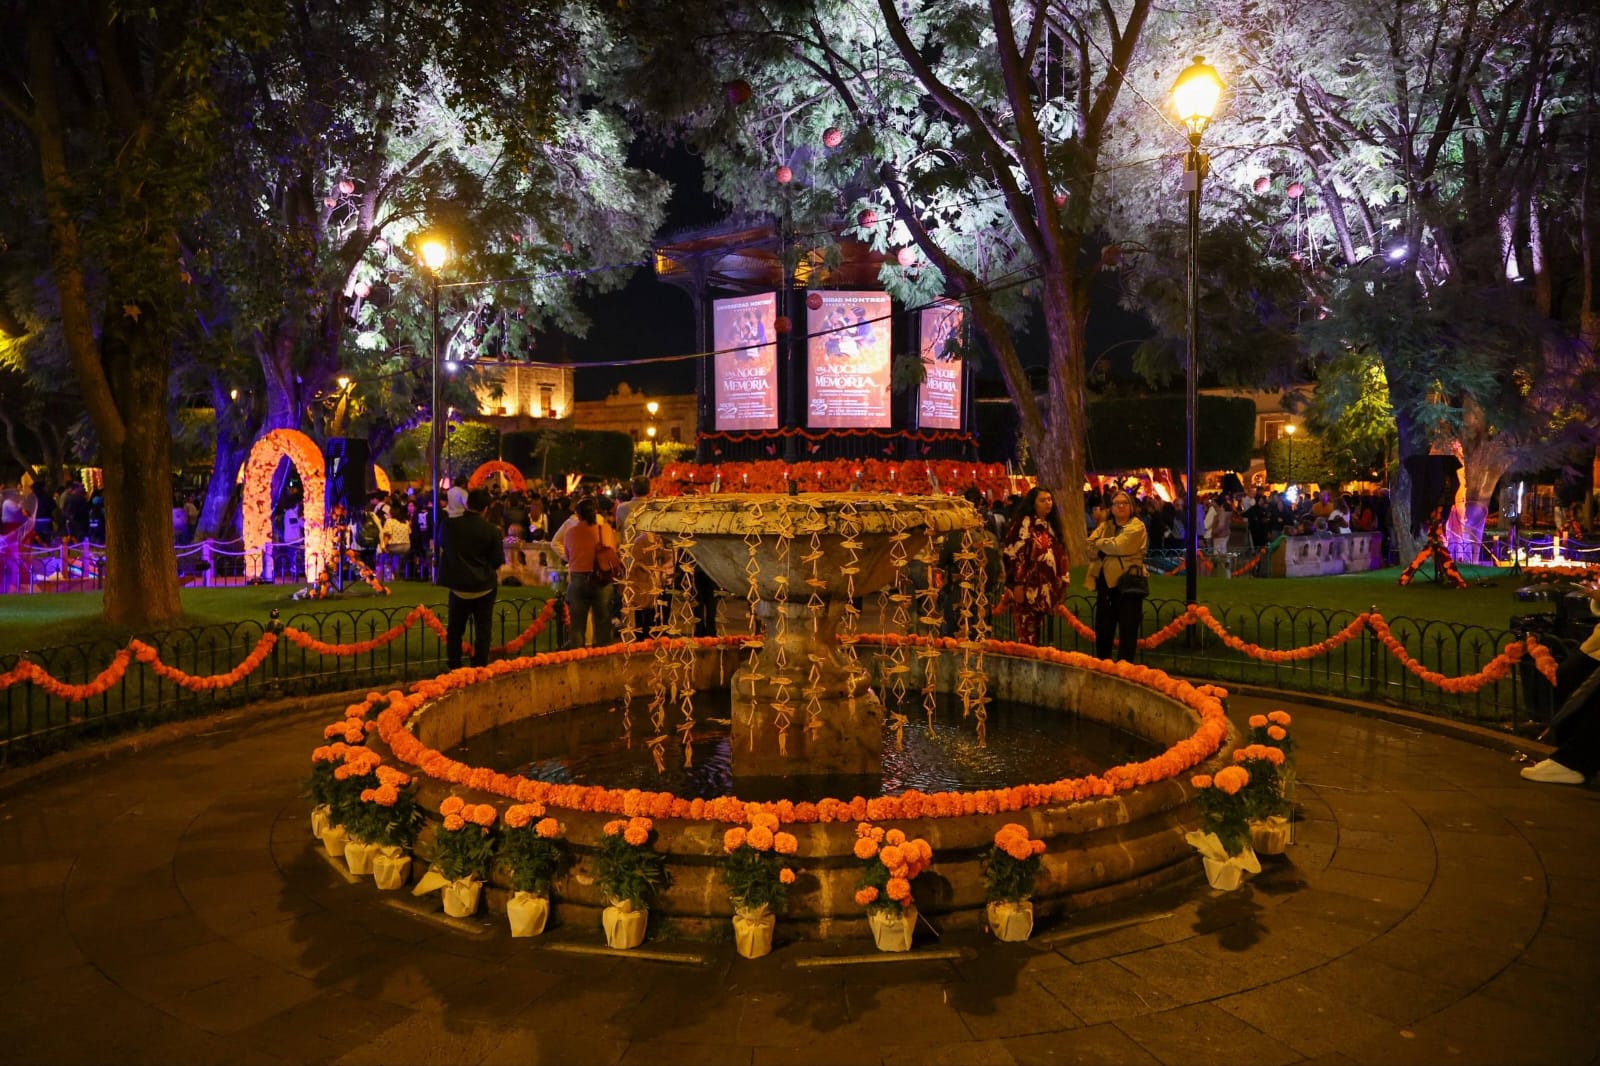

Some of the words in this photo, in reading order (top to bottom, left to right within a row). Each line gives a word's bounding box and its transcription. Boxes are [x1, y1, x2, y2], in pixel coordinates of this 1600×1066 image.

[737, 367, 767, 377] NOCHE
[828, 364, 873, 375] NOCHE
[723, 379, 771, 392] MEMORIA
[815, 375, 880, 389] MEMORIA
[926, 377, 957, 392] MEMORIA
